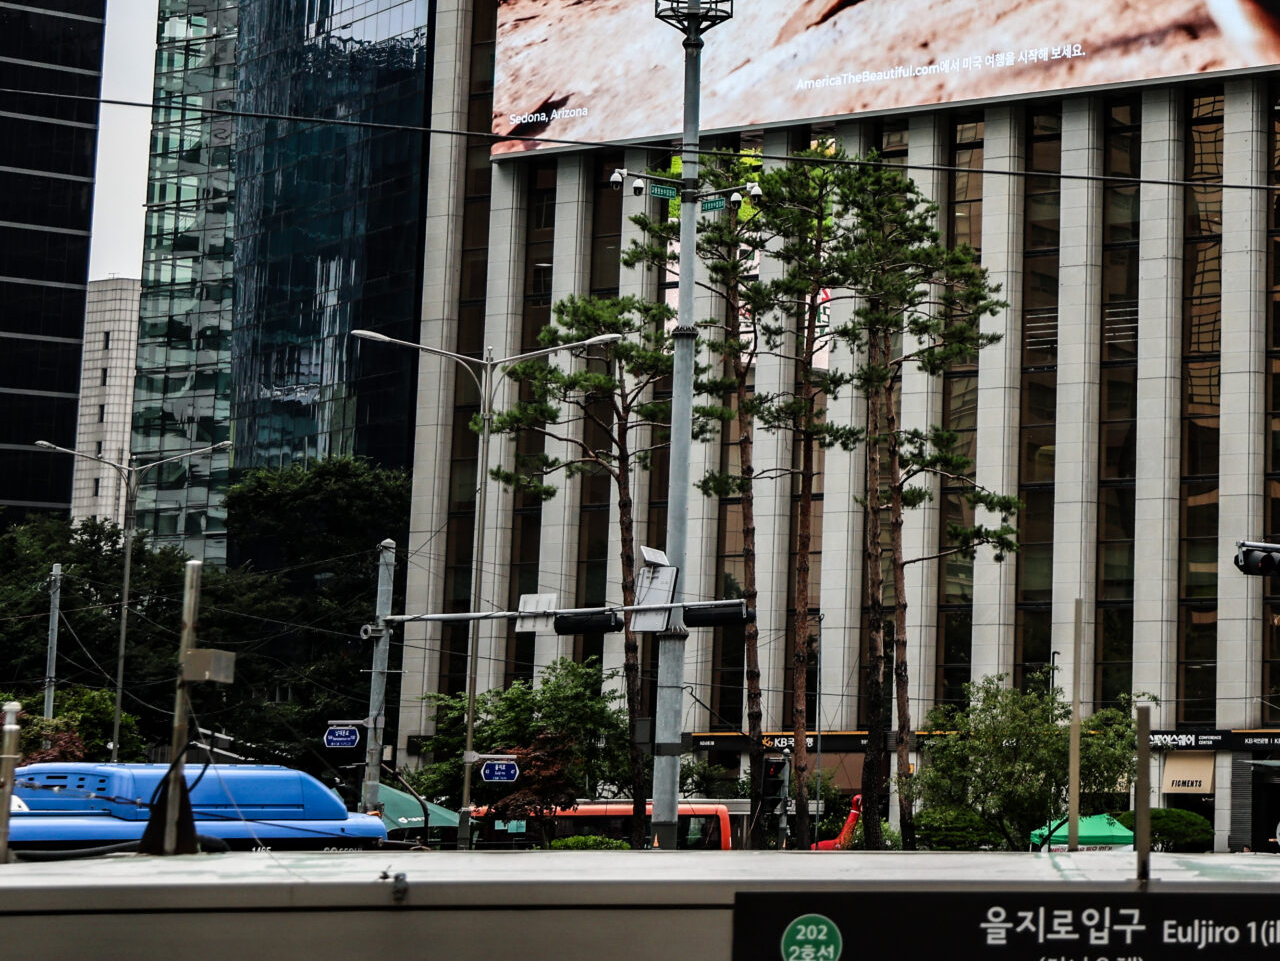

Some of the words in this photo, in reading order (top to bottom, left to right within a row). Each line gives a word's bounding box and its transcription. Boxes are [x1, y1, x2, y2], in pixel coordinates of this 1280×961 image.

[962, 55, 982, 72] 미국
[984, 51, 1015, 70] 여행을
[1017, 46, 1049, 65] 시작해
[1051, 43, 1086, 60] 보세요.
[509, 111, 548, 125] Sedona,
[550, 106, 588, 120] Arizona
[774, 737, 814, 748] KB국행
[796, 924, 828, 940] 202
[979, 906, 1146, 945] 을지로입구
[1163, 919, 1239, 949] Euljiro
